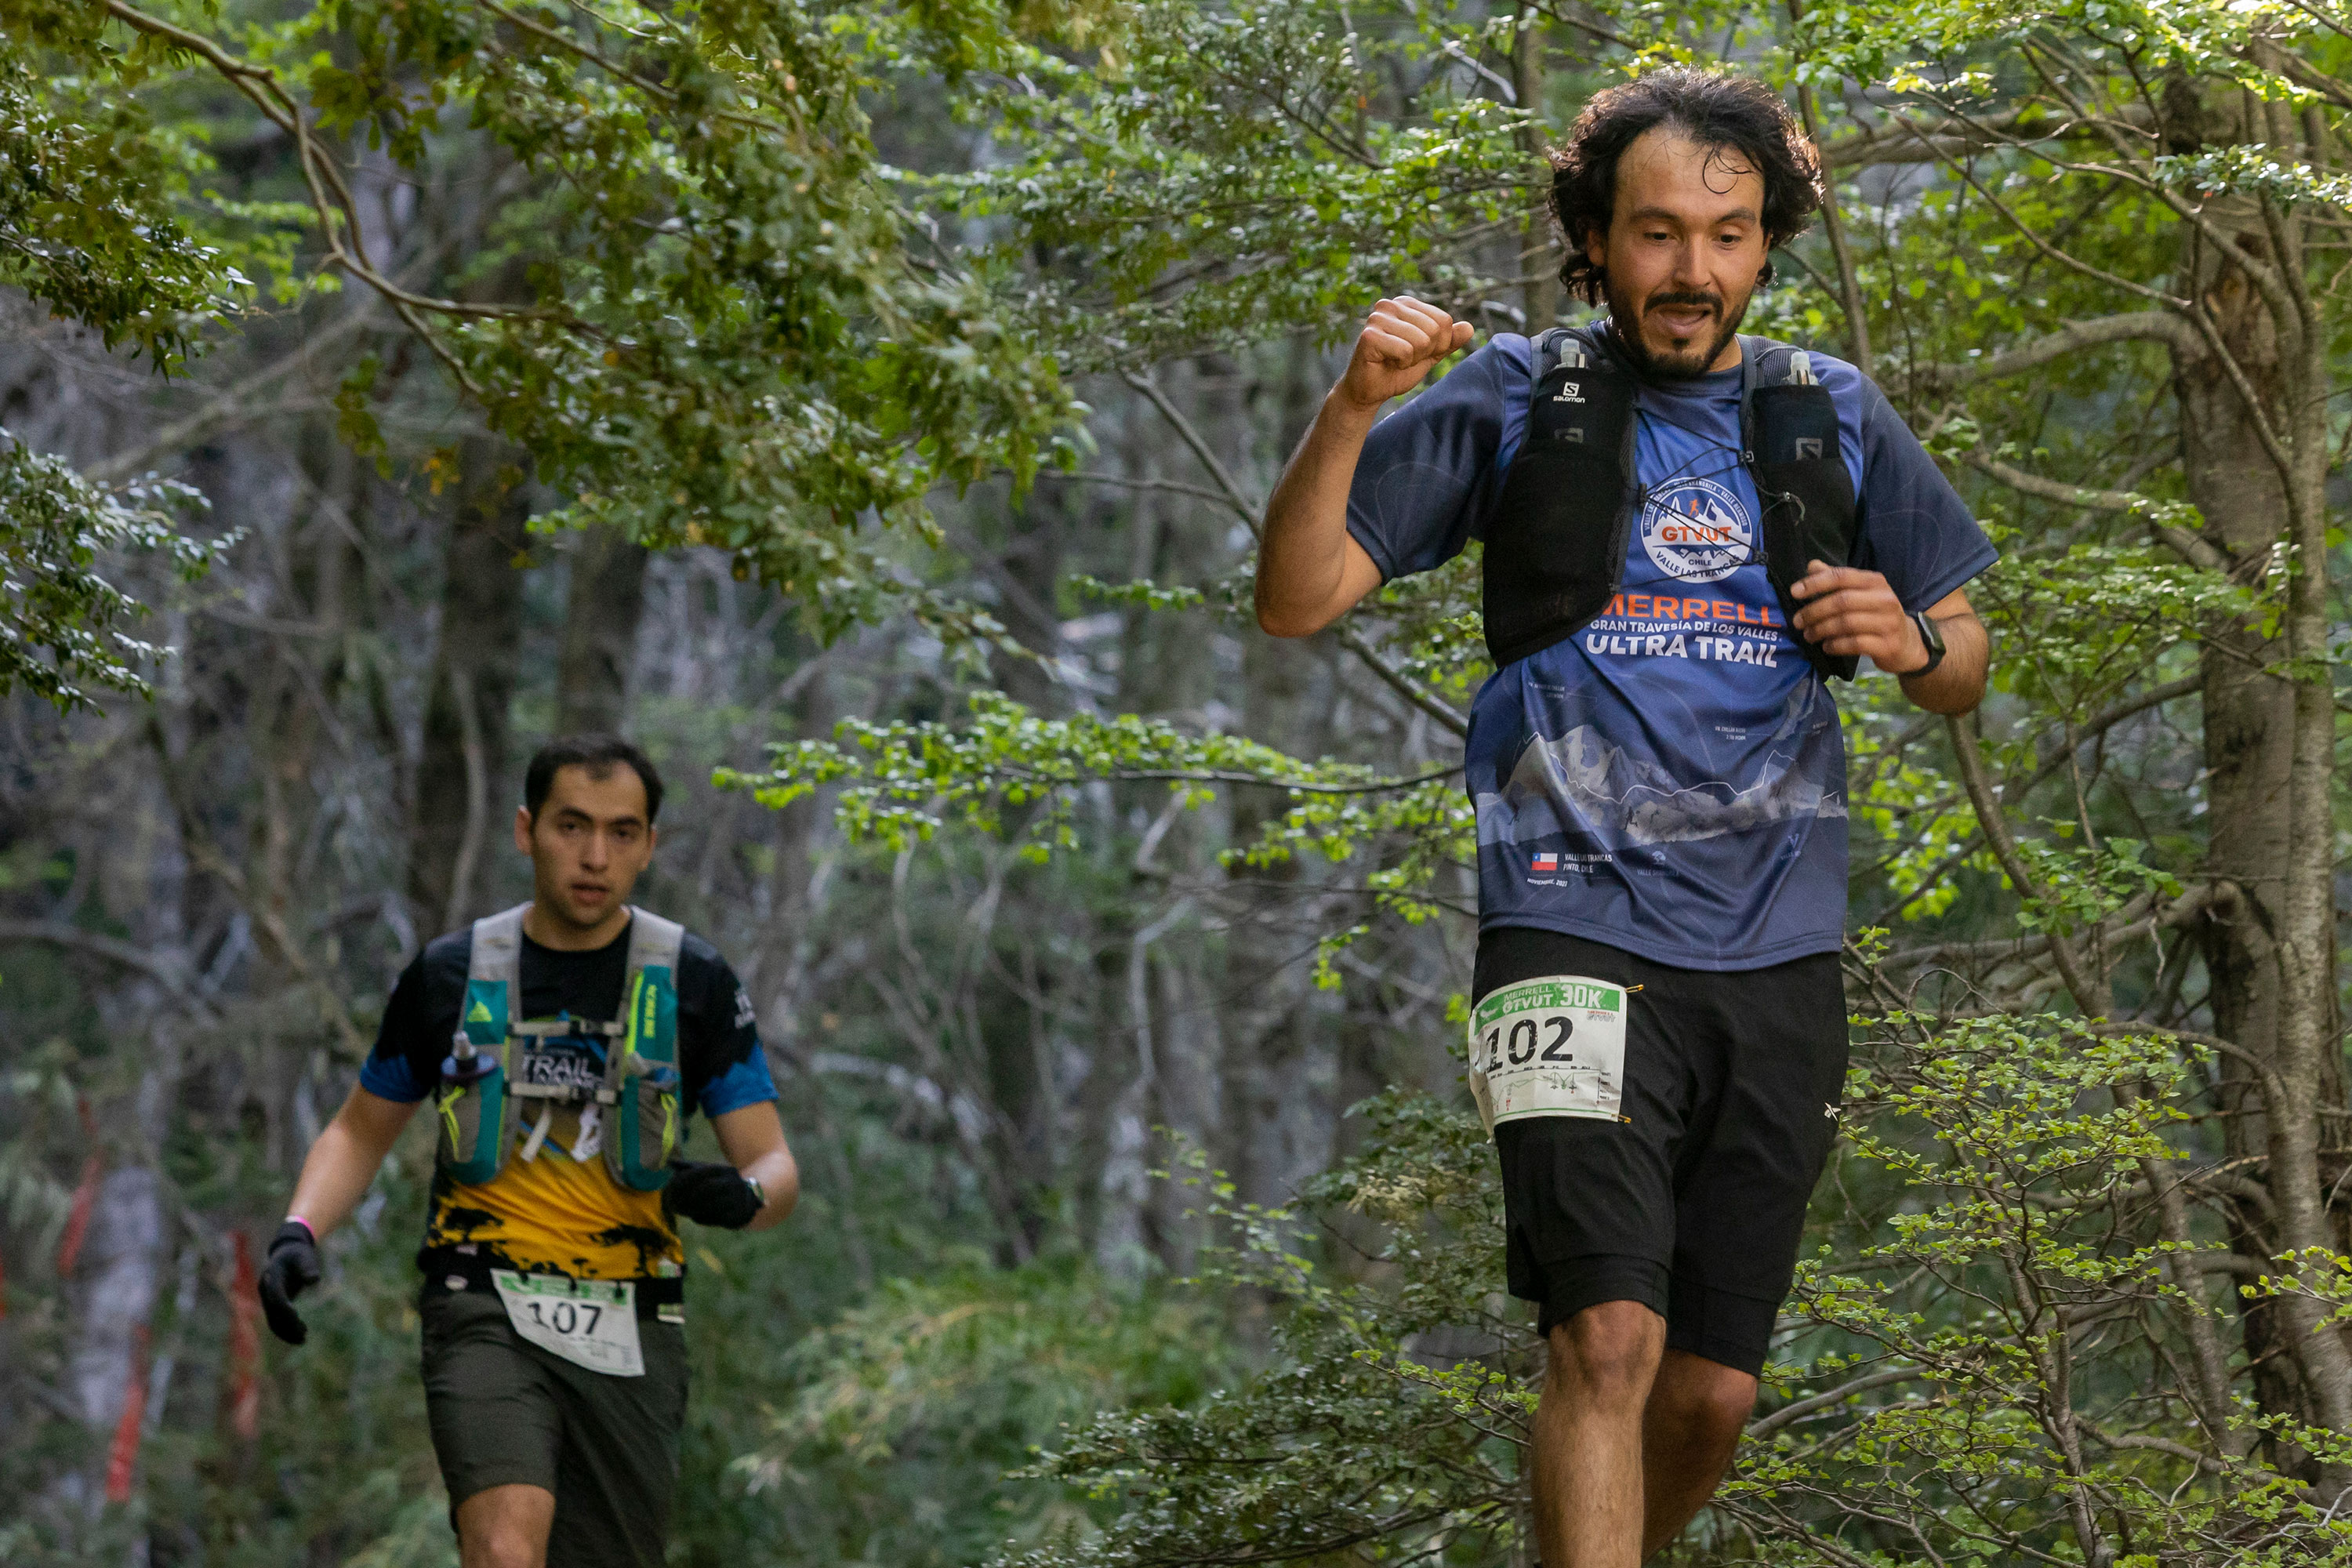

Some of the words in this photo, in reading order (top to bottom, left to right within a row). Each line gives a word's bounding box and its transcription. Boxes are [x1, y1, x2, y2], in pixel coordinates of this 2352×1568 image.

[1720, 490, 1734, 505] VALLE
[1661, 526, 1731, 542] GTVUT
[1656, 550, 1679, 574] VALLE
[1680, 568, 1697, 578] LAS
[1590, 619, 1627, 632] GRAN
[1629, 619, 1693, 633] TRAVESÍA
[1694, 621, 1711, 632] DE
[1712, 622, 1734, 634] LOS
[1737, 626, 1778, 642] VALLES
[1586, 633, 1688, 659] ULTRA
[1694, 635, 1777, 668] TRAIL
[1588, 854, 1613, 862] TRANCAS
[1504, 985, 1552, 999] MERRELL
[1560, 984, 1602, 1009] 30K
[1486, 1016, 1573, 1073] 102
[528, 1301, 602, 1334] 107
